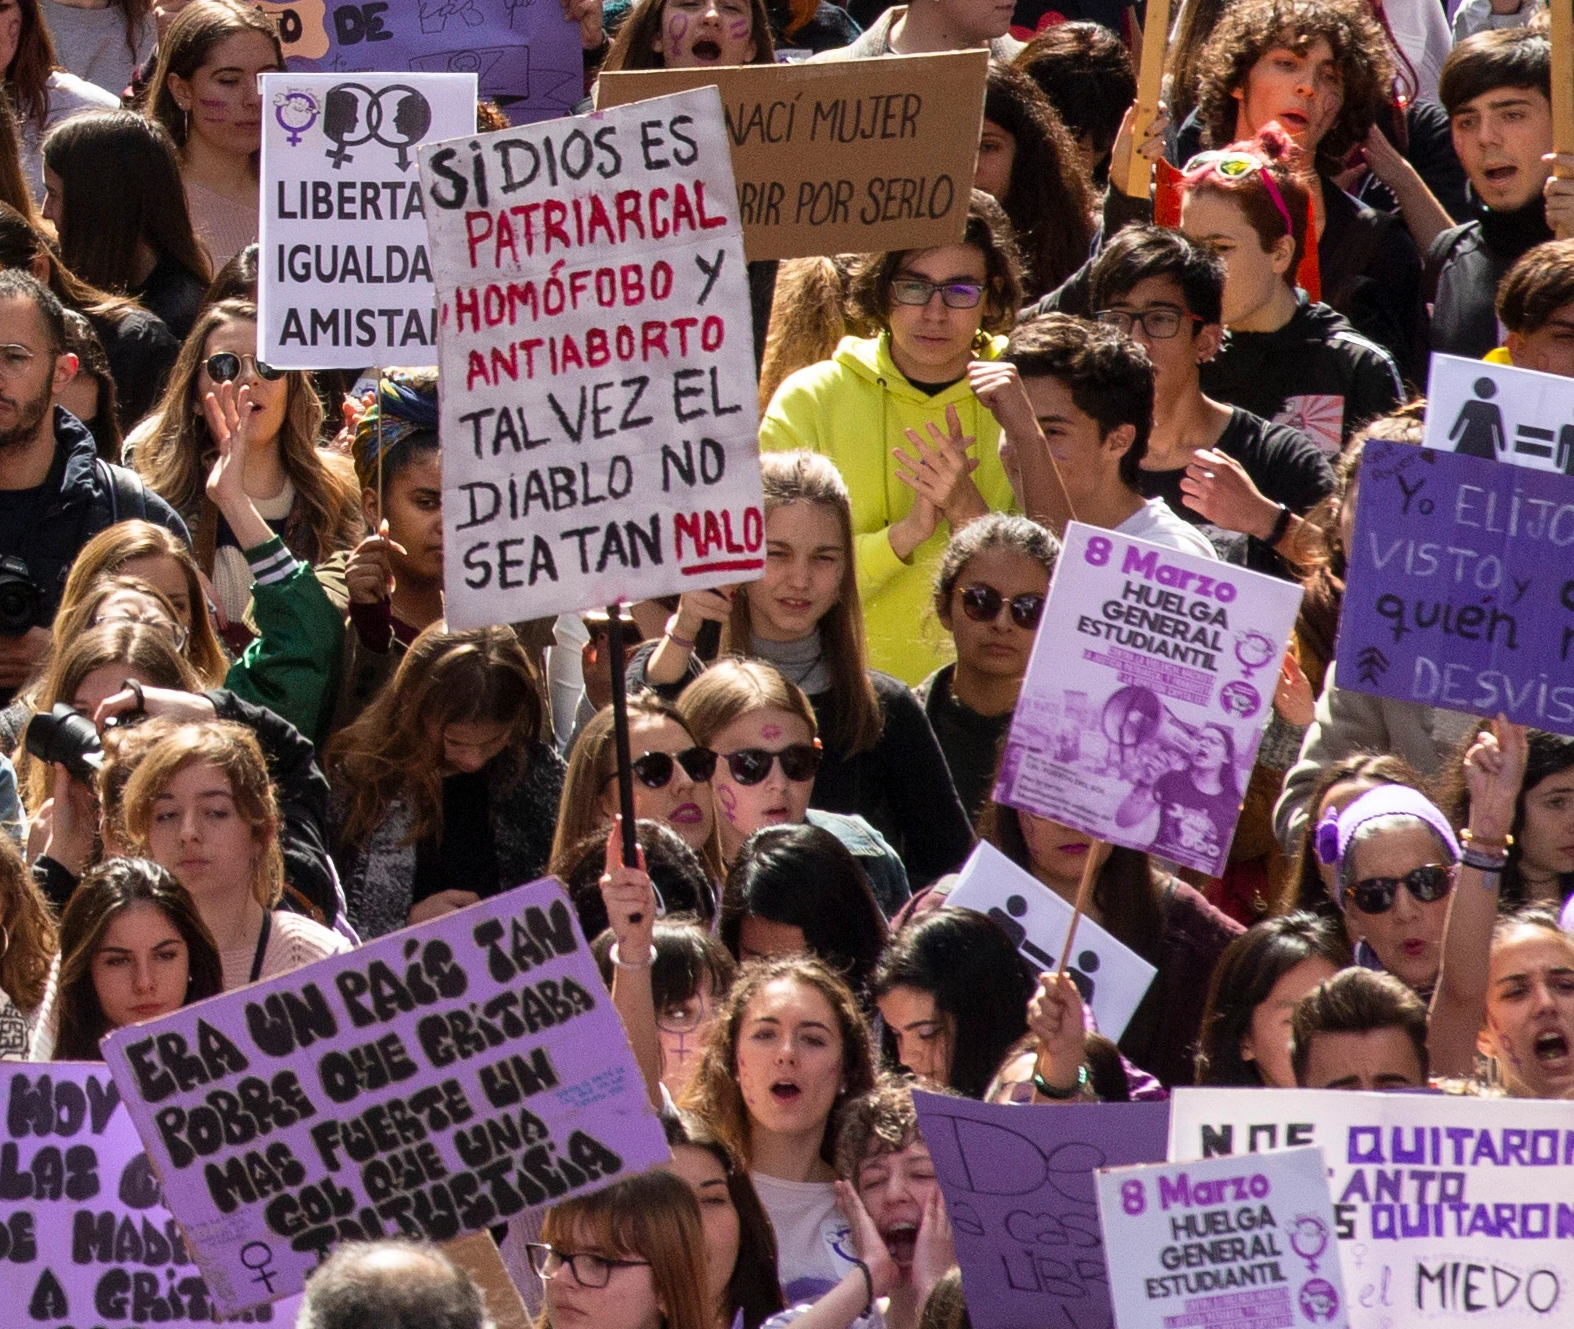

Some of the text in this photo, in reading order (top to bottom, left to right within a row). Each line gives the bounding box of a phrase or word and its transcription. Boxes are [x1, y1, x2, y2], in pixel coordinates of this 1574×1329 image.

[809, 93, 922, 143] MUJER
[277, 180, 426, 221] LIBERTA
[465, 179, 727, 268] PATRIARCAL
[453, 250, 726, 333] HOMÓFOBO Y
[466, 315, 726, 392] ANTIABORTO
[459, 366, 741, 460] TAL VEZ EL
[456, 437, 726, 530] DIABLO NO
[463, 505, 765, 590] SEA TAN MALO
[1082, 535, 1238, 604] 8 Marzo
[1101, 599, 1225, 653] GENERAL
[1121, 579, 1231, 631] HUELGA
[1077, 615, 1220, 672] ESTUDIANTIL
[125, 898, 579, 1104] ERA UN PAÍS TAN
[155, 975, 597, 1168] POBRE QUE GRITABA
[6, 1073, 122, 1139] HOY
[203, 1142, 307, 1216] MAS
[309, 1076, 476, 1173] FUERTE
[477, 1046, 560, 1110] UN
[1120, 1173, 1271, 1216] 8 Marzo
[1170, 1204, 1278, 1241] HUELGA
[1145, 1261, 1288, 1300] ESTUDIANTIL
[1160, 1232, 1283, 1271] GENERAL
[27, 1267, 69, 1320] A
